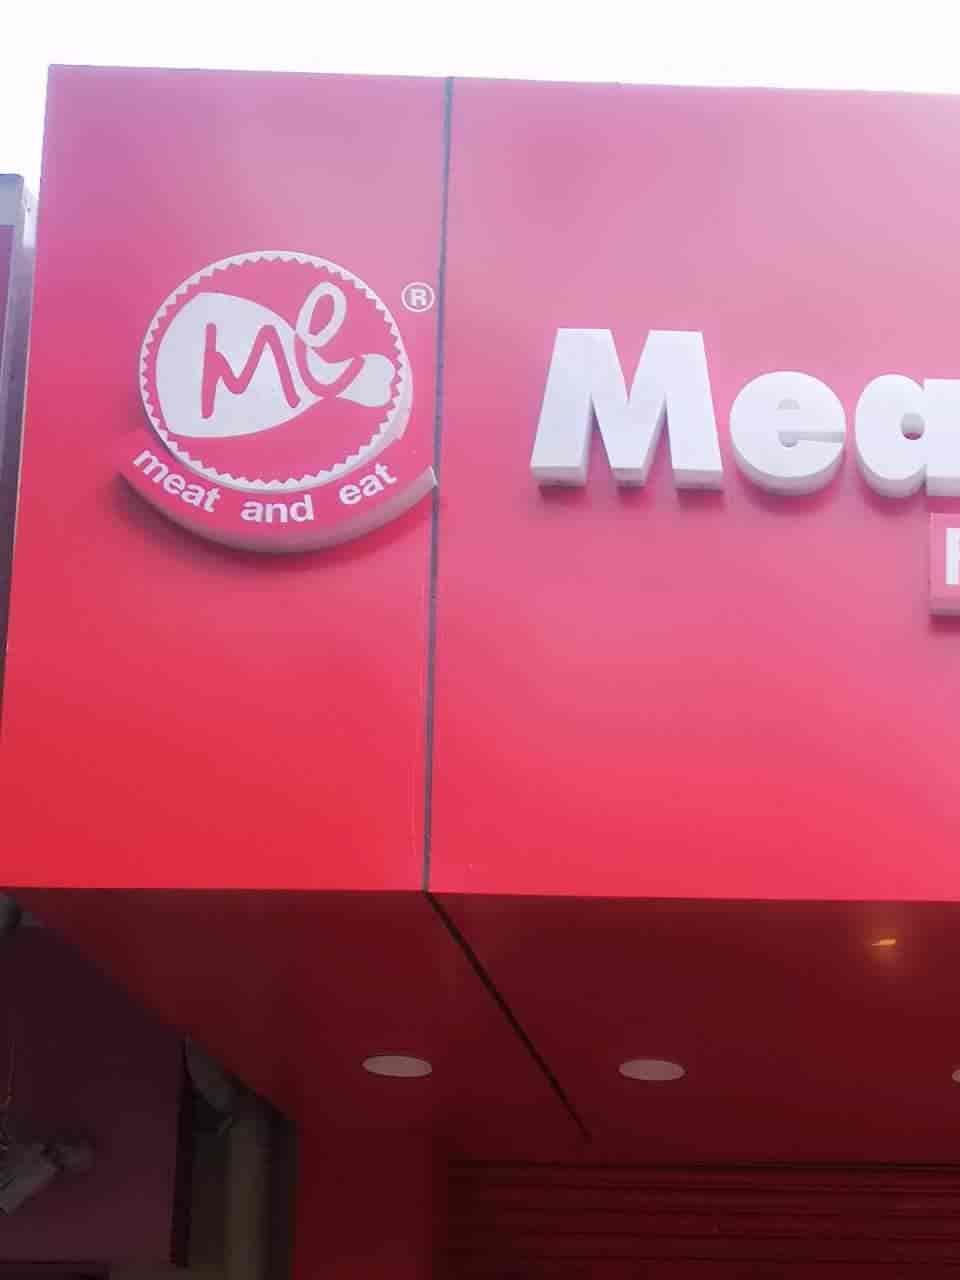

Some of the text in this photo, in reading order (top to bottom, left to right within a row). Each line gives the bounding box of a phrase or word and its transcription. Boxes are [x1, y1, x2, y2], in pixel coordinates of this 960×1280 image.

[133, 450, 397, 523] meat and eat
